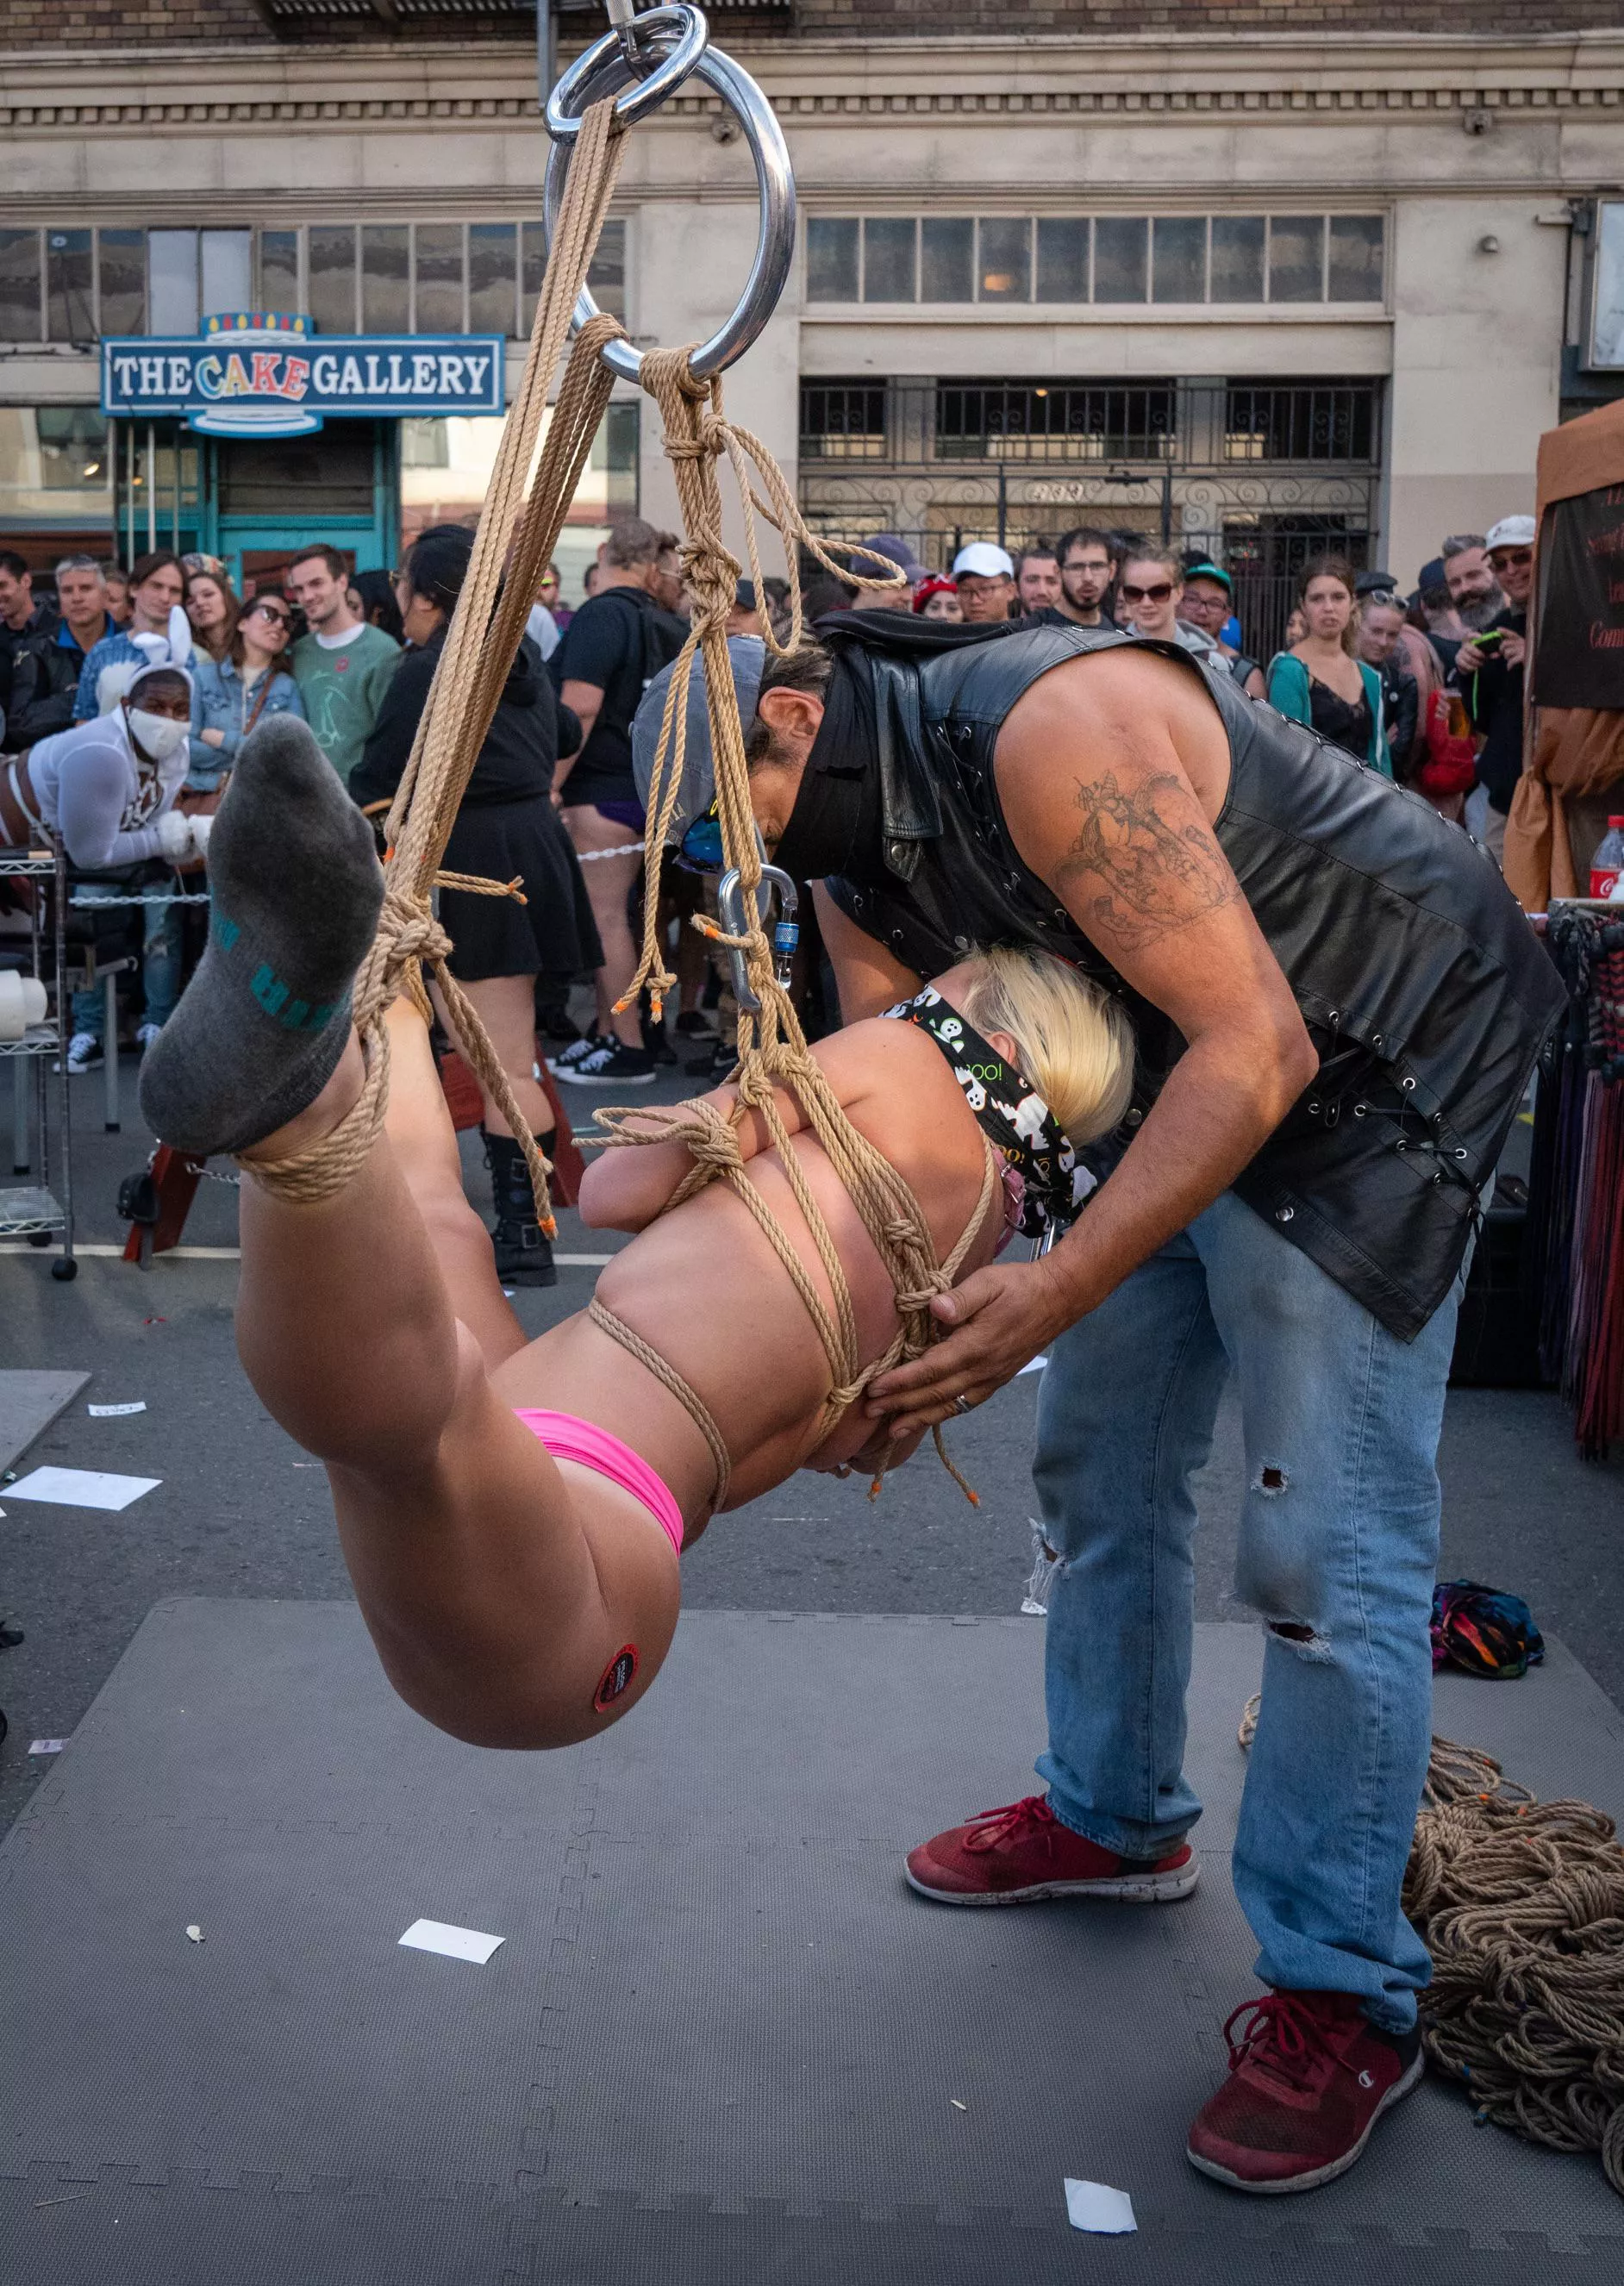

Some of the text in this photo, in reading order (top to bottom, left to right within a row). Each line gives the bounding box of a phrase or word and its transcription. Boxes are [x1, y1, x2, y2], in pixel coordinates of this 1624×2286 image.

[113, 352, 490, 402] THE CAKE GALLERY
